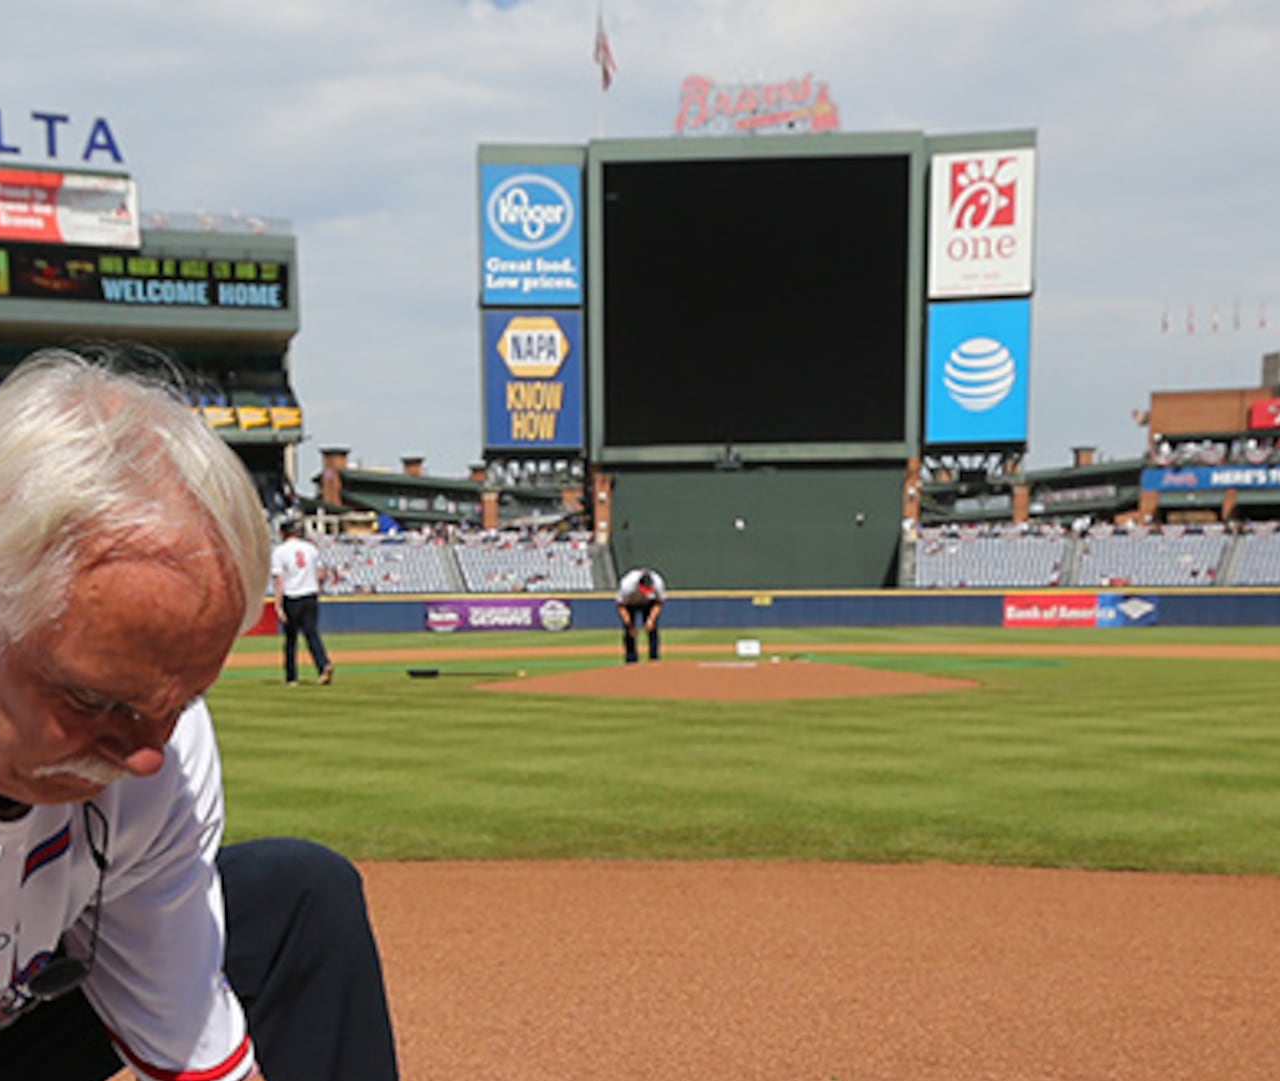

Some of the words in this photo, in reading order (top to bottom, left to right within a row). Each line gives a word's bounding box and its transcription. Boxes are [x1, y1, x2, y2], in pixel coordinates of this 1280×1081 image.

[499, 188, 564, 240] Kroger
[946, 233, 1017, 263] one
[486, 256, 533, 274] Great
[535, 256, 577, 274] food.
[101, 277, 208, 306] WELCOME
[218, 282, 281, 310] HOME
[486, 274, 519, 289] Low
[522, 275, 579, 294] prices.
[511, 334, 558, 360] NAPA
[505, 381, 564, 411] KNOW
[512, 410, 557, 440] HOW
[1210, 467, 1268, 487] HERE'S
[1005, 604, 1039, 620] Bank
[1043, 604, 1058, 620] of
[1058, 604, 1117, 621] America
